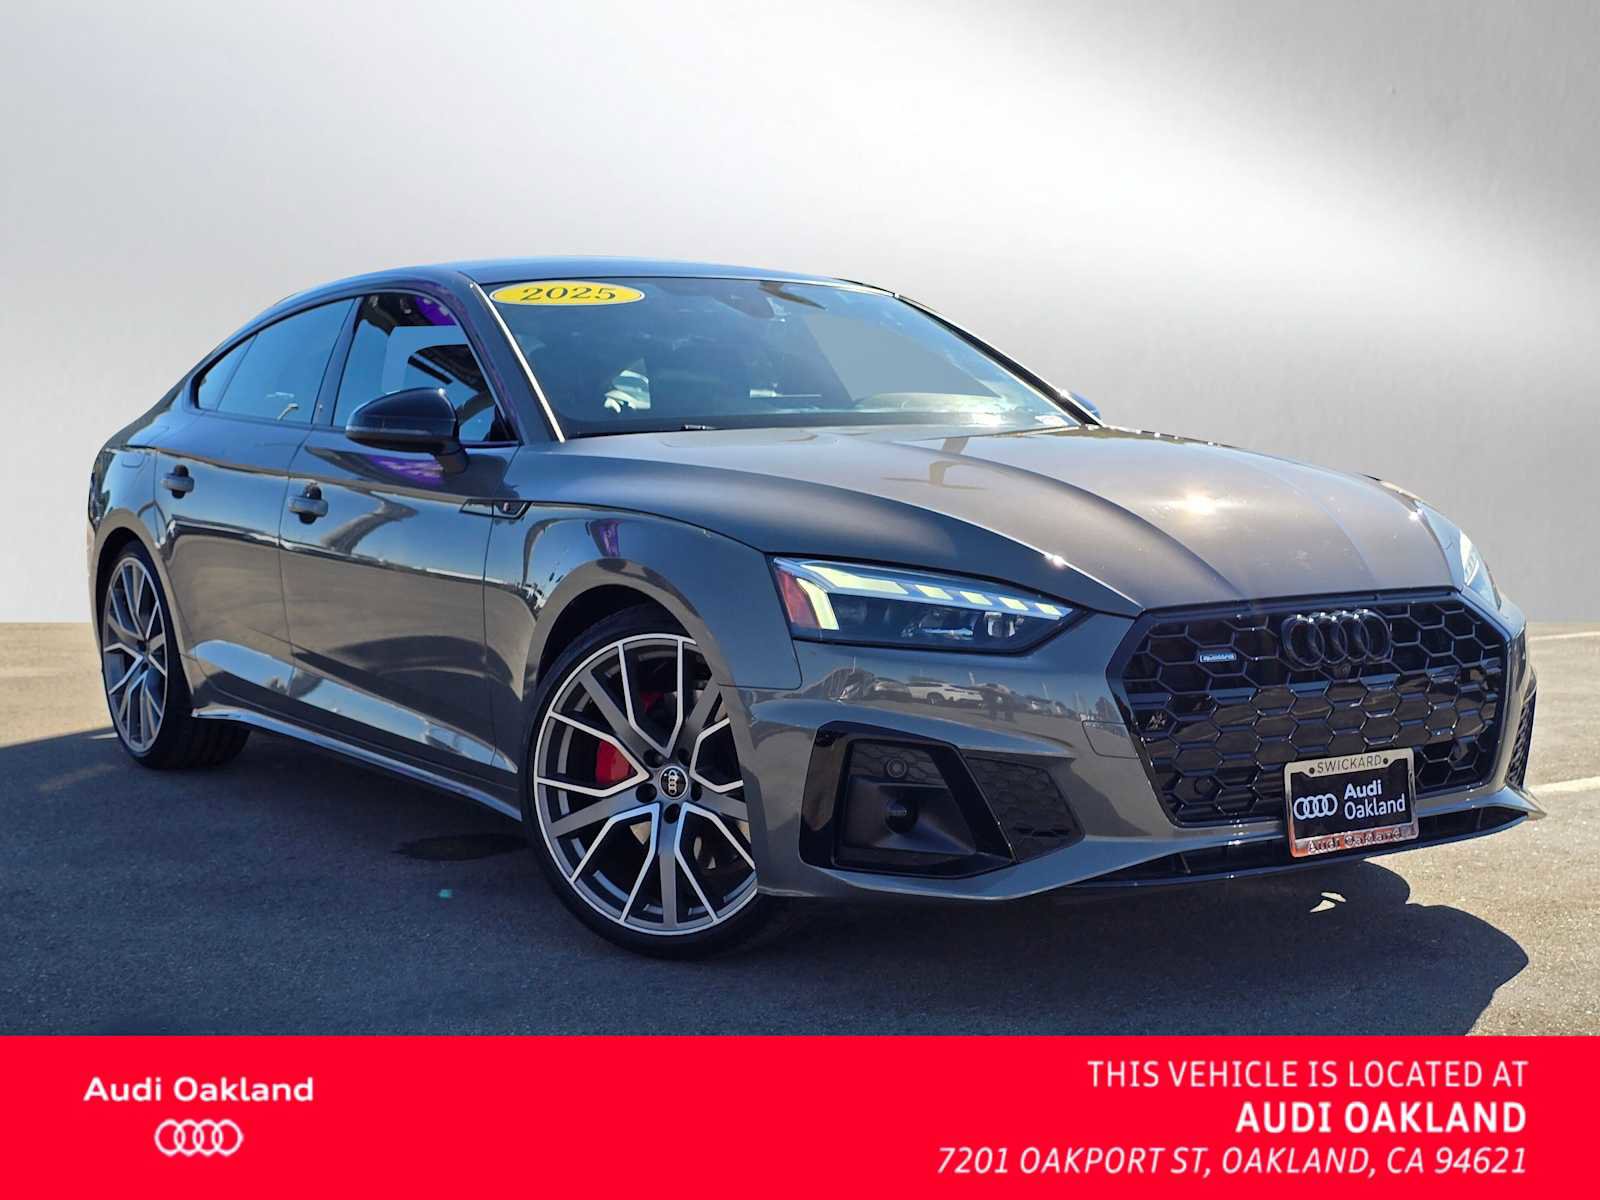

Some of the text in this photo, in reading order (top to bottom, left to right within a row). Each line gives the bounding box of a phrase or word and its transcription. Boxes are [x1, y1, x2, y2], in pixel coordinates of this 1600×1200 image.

[520, 286, 616, 301] 2025
[1316, 754, 1382, 774] SWICKARD
[1344, 779, 1382, 799] Audi
[1344, 793, 1406, 820] Oakland
[1308, 836, 1342, 855] Audi
